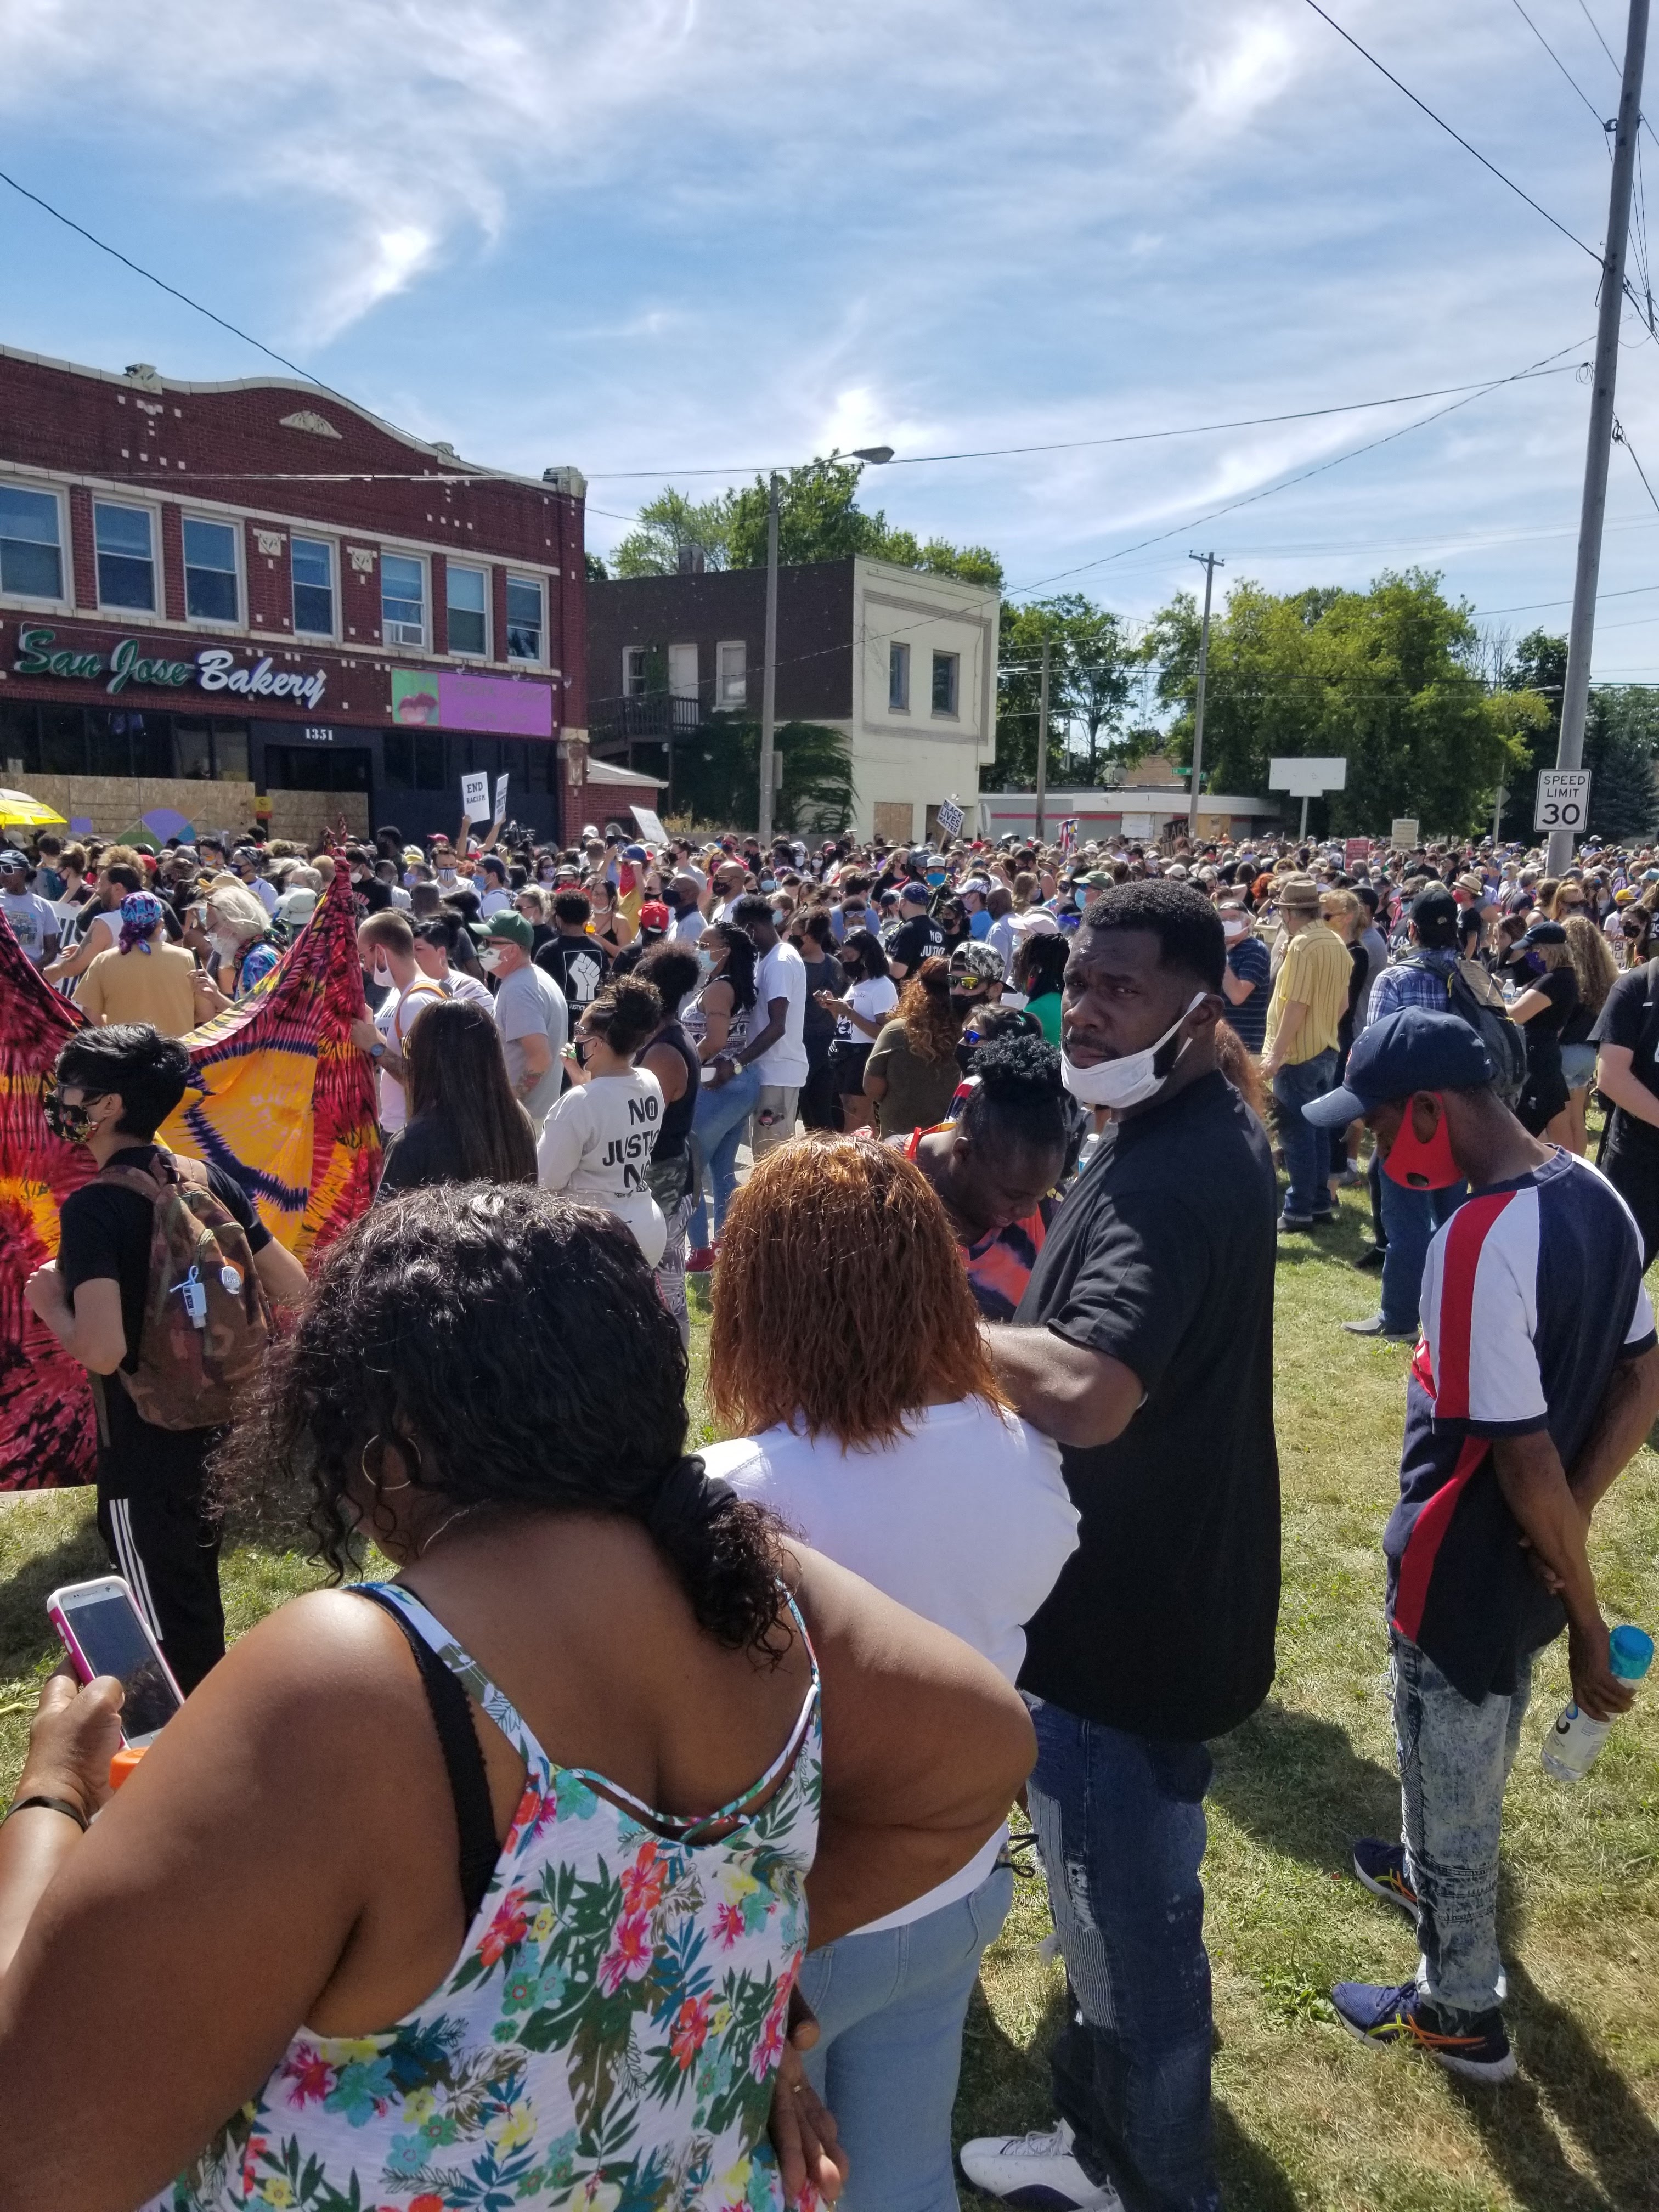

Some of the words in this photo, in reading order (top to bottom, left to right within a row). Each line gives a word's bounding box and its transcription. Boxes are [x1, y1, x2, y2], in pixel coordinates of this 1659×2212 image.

[14, 629, 101, 679] San
[106, 639, 190, 694] Jose
[198, 650, 328, 710] Bakery
[305, 728, 333, 740] 1351
[466, 781, 483, 794] END
[1544, 776, 1585, 785] SPEED
[466, 794, 486, 804] RACISM
[1547, 788, 1580, 798] LIMIT
[940, 807, 961, 828] LIVES
[943, 800, 963, 821] BLACK
[1542, 803, 1580, 825] 30
[938, 815, 958, 834] MATTER
[929, 930, 943, 944] NO
[628, 1095, 658, 1126] NO
[602, 1128, 659, 1167] JUSTIC
